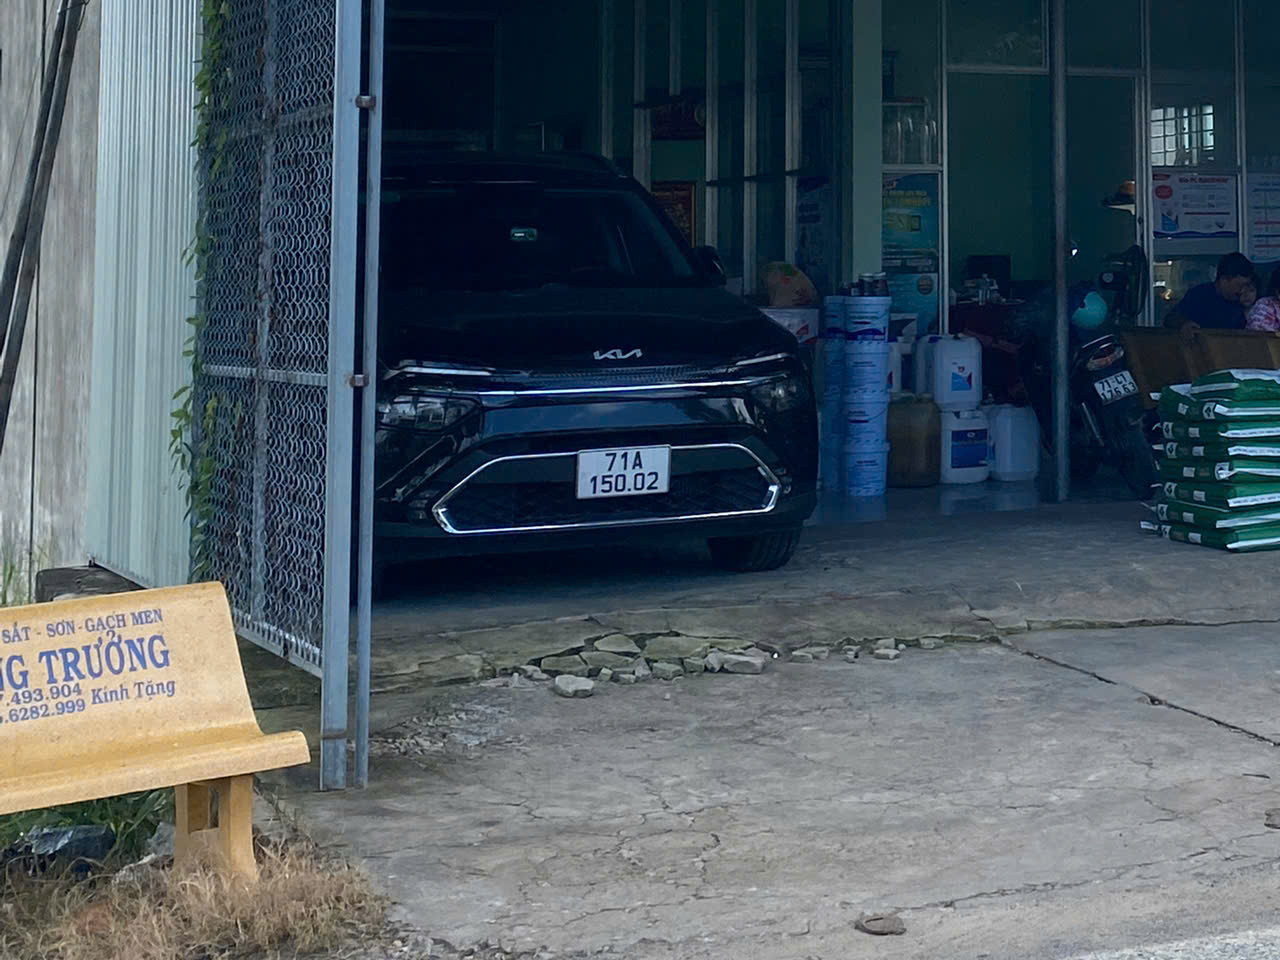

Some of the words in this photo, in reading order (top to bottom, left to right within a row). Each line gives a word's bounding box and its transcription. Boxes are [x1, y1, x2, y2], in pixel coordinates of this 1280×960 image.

[605, 451, 643, 471] 71A
[589, 472, 659, 494] 150.02
[130, 607, 163, 625] MEN
[39, 630, 170, 685] TRƯỞNG
[134, 679, 176, 701] Tặng
